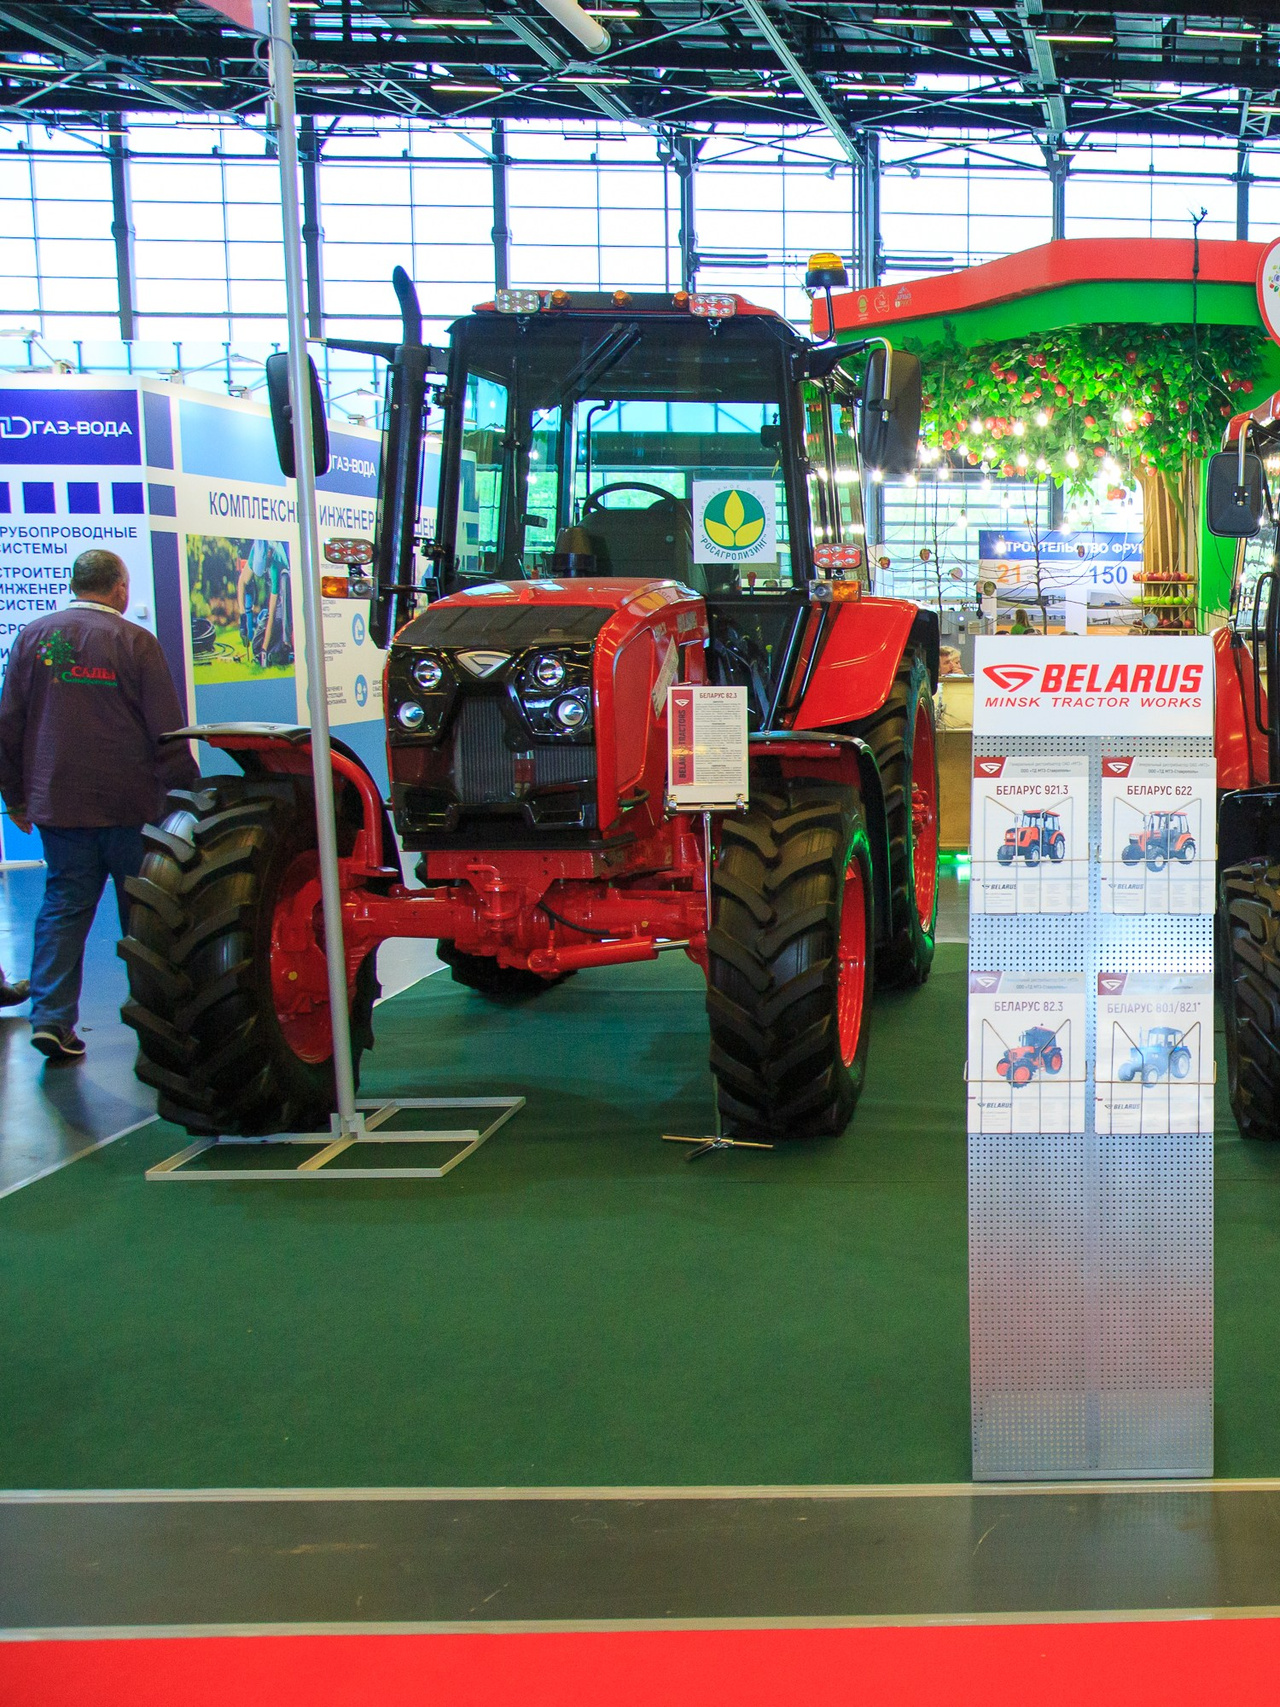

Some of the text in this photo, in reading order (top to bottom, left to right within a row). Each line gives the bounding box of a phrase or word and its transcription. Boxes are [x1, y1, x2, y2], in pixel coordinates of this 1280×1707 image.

[32, 421, 133, 438] ГАЗ-ВОДА
[331, 454, 377, 478] ГАЗ-ВОДА
[209, 491, 382, 531] КОМПЛЕКСН ИНЖЕНЕР
[0, 542, 68, 554] ИСТЕМЫ
[701, 532, 768, 561] "РОСАГРОЛИЗИНГ"
[999, 541, 1109, 554] ТРОИТЕЛЬСТВО
[0, 567, 72, 579] ТРОИТЕЛ
[996, 564, 1021, 584] 21
[1088, 565, 1128, 585] 150
[0, 583, 72, 595] НЖЕНЕР
[1040, 664, 1204, 693] BELARUS
[984, 697, 1202, 708] MINSK TRACTOR WORKS
[996, 785, 1068, 795] БЕЛАРУС 921.3
[1127, 785, 1192, 796] БЕЛАРУС 622
[994, 1001, 1064, 1012] БЕЛАРУС 82.3
[1107, 1002, 1153, 1014] БЕЛАРУС
